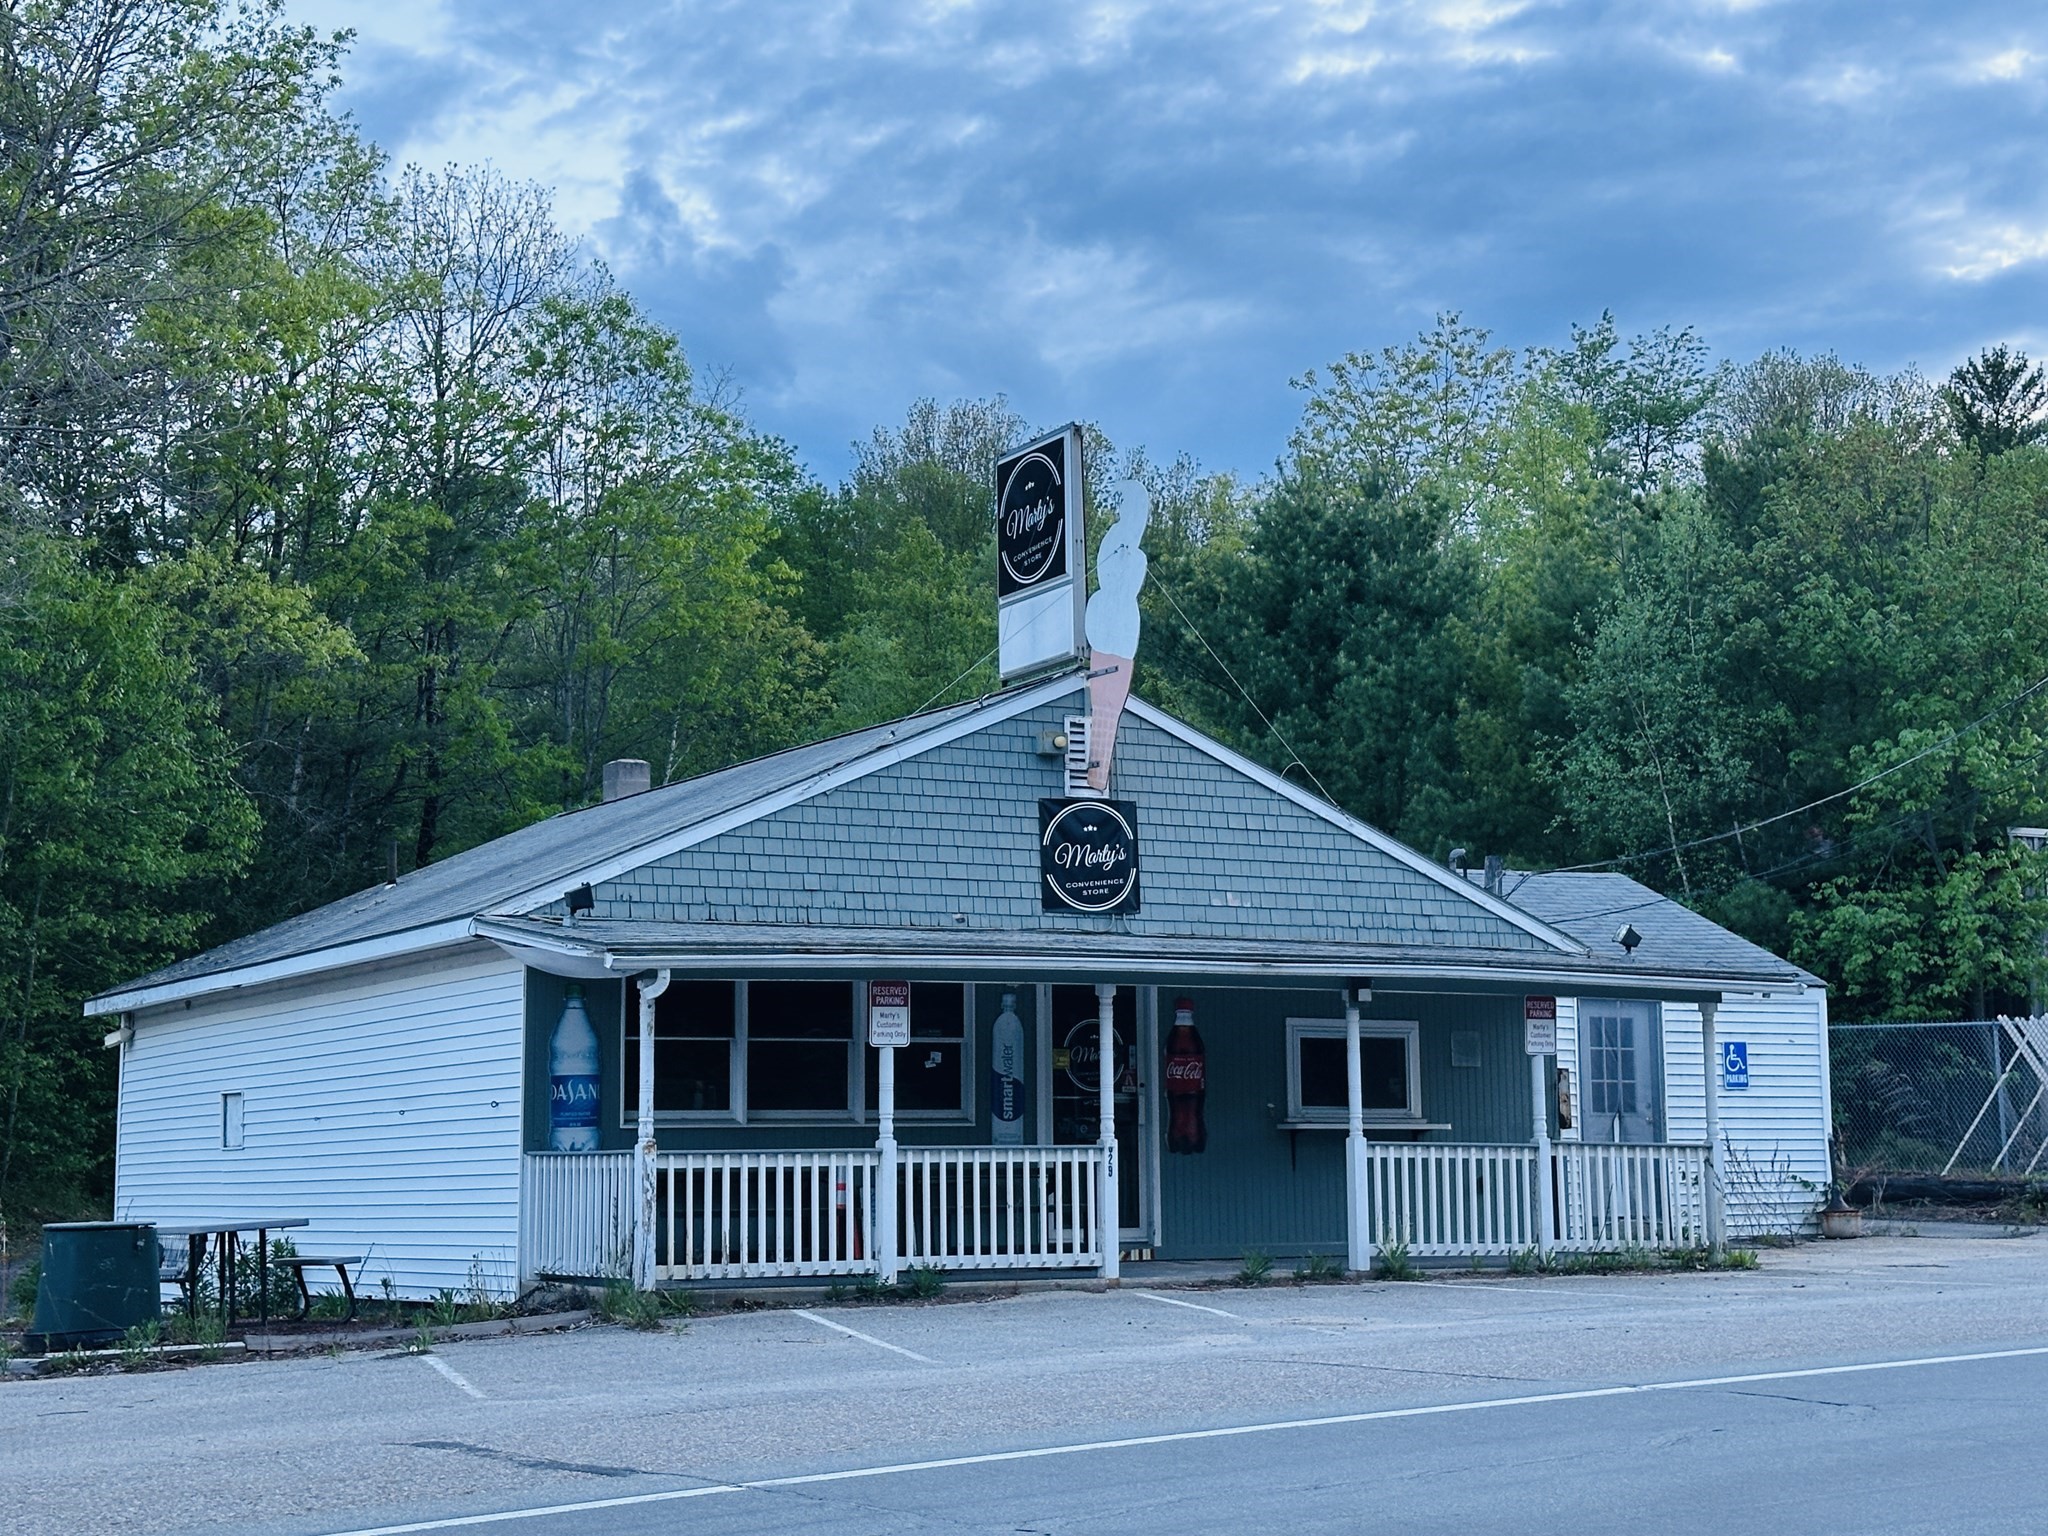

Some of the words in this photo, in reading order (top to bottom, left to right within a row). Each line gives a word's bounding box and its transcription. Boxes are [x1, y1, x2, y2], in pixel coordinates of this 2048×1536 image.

[1006, 496, 1055, 540] Marty's
[1013, 536, 1053, 562] CONVENIENCE
[1023, 552, 1042, 566] STORE
[1054, 842, 1127, 871] Marty's
[1065, 878, 1125, 889] CONVENIENCE
[1082, 888, 1109, 896] STORE
[872, 986, 908, 996] RESERVED
[875, 996, 905, 1005] PARKING
[1526, 1000, 1555, 1009] RESERVED
[879, 1011, 900, 1020] Marty's
[1530, 1010, 1552, 1018] PARKING
[876, 1020, 903, 1028] Customer
[873, 1031, 893, 1040] Parking
[894, 1030, 907, 1039] Only
[1726, 1073, 1748, 1084] PARKING
